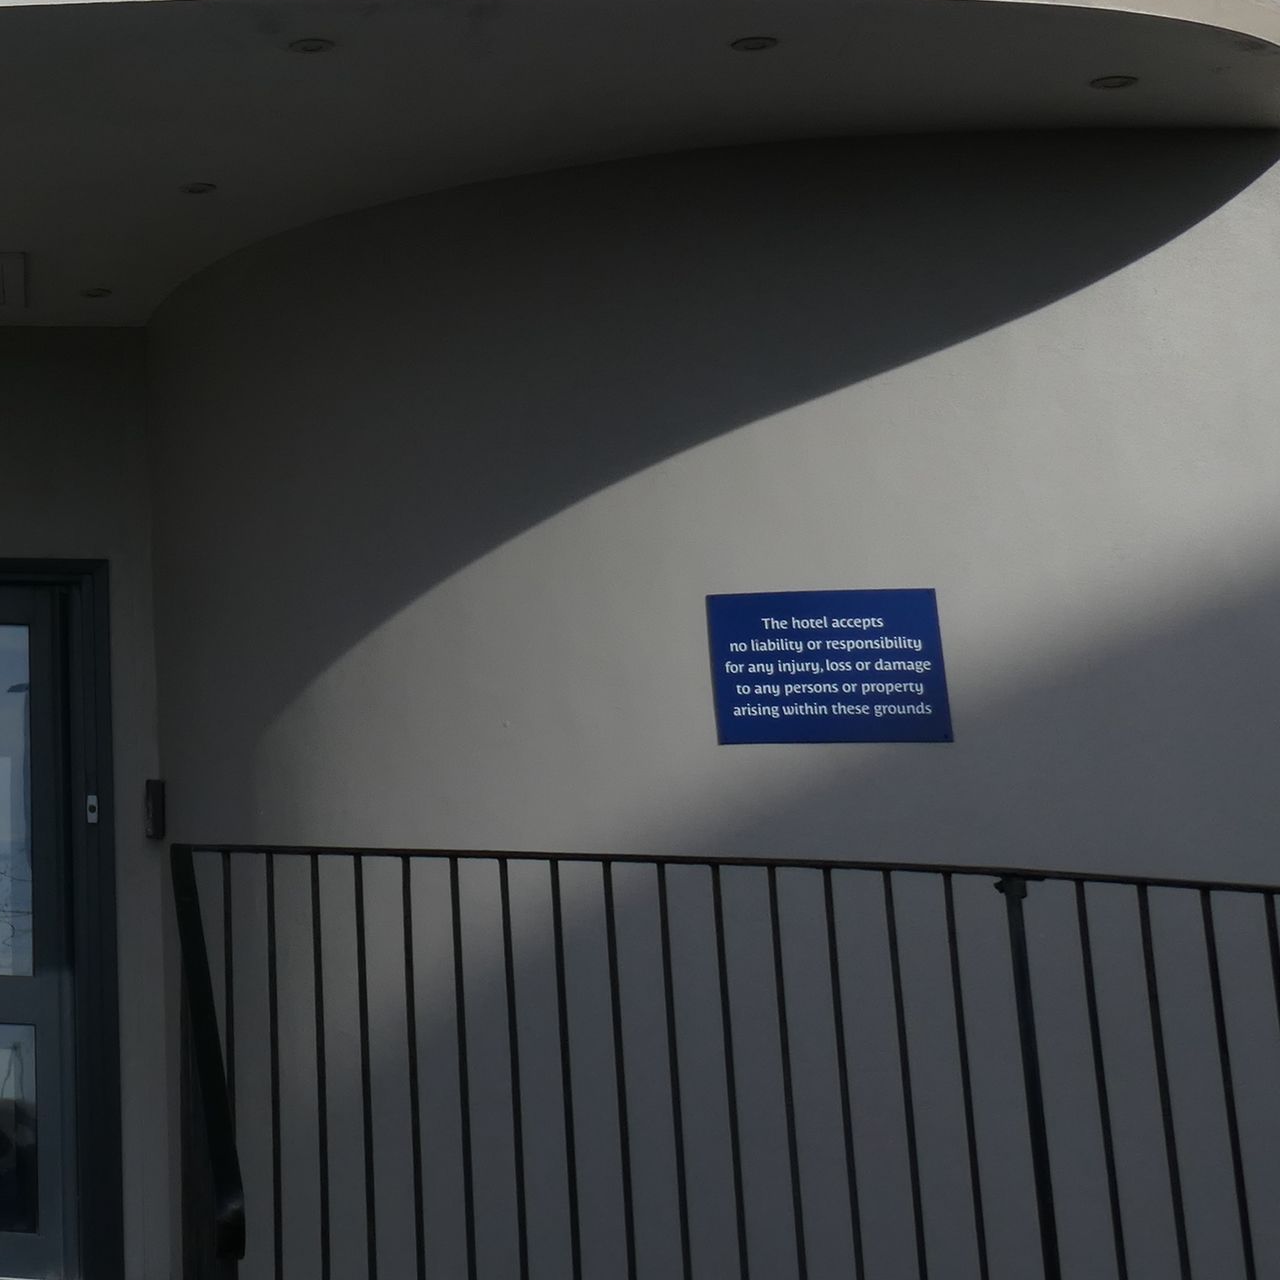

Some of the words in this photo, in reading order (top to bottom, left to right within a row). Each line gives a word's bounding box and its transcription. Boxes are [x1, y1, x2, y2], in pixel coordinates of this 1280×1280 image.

[762, 618, 788, 629] The
[792, 617, 828, 629] hotel
[832, 618, 884, 630] accepts
[730, 642, 747, 652] no
[751, 639, 803, 652] liability
[807, 640, 823, 650] or
[827, 637, 922, 651] responsibility
[725, 661, 744, 673] for
[748, 662, 774, 675] any
[778, 660, 824, 674] injury,
[826, 659, 852, 672] loss
[856, 660, 871, 671] or
[875, 659, 931, 673] damage
[737, 684, 750, 695] to
[754, 684, 780, 696] any
[785, 682, 838, 696] persons
[842, 682, 857, 693] or
[862, 682, 924, 695] property
[733, 703, 779, 718] arising
[782, 703, 828, 715] within
[832, 703, 870, 714] these
[874, 702, 932, 717] grounds
